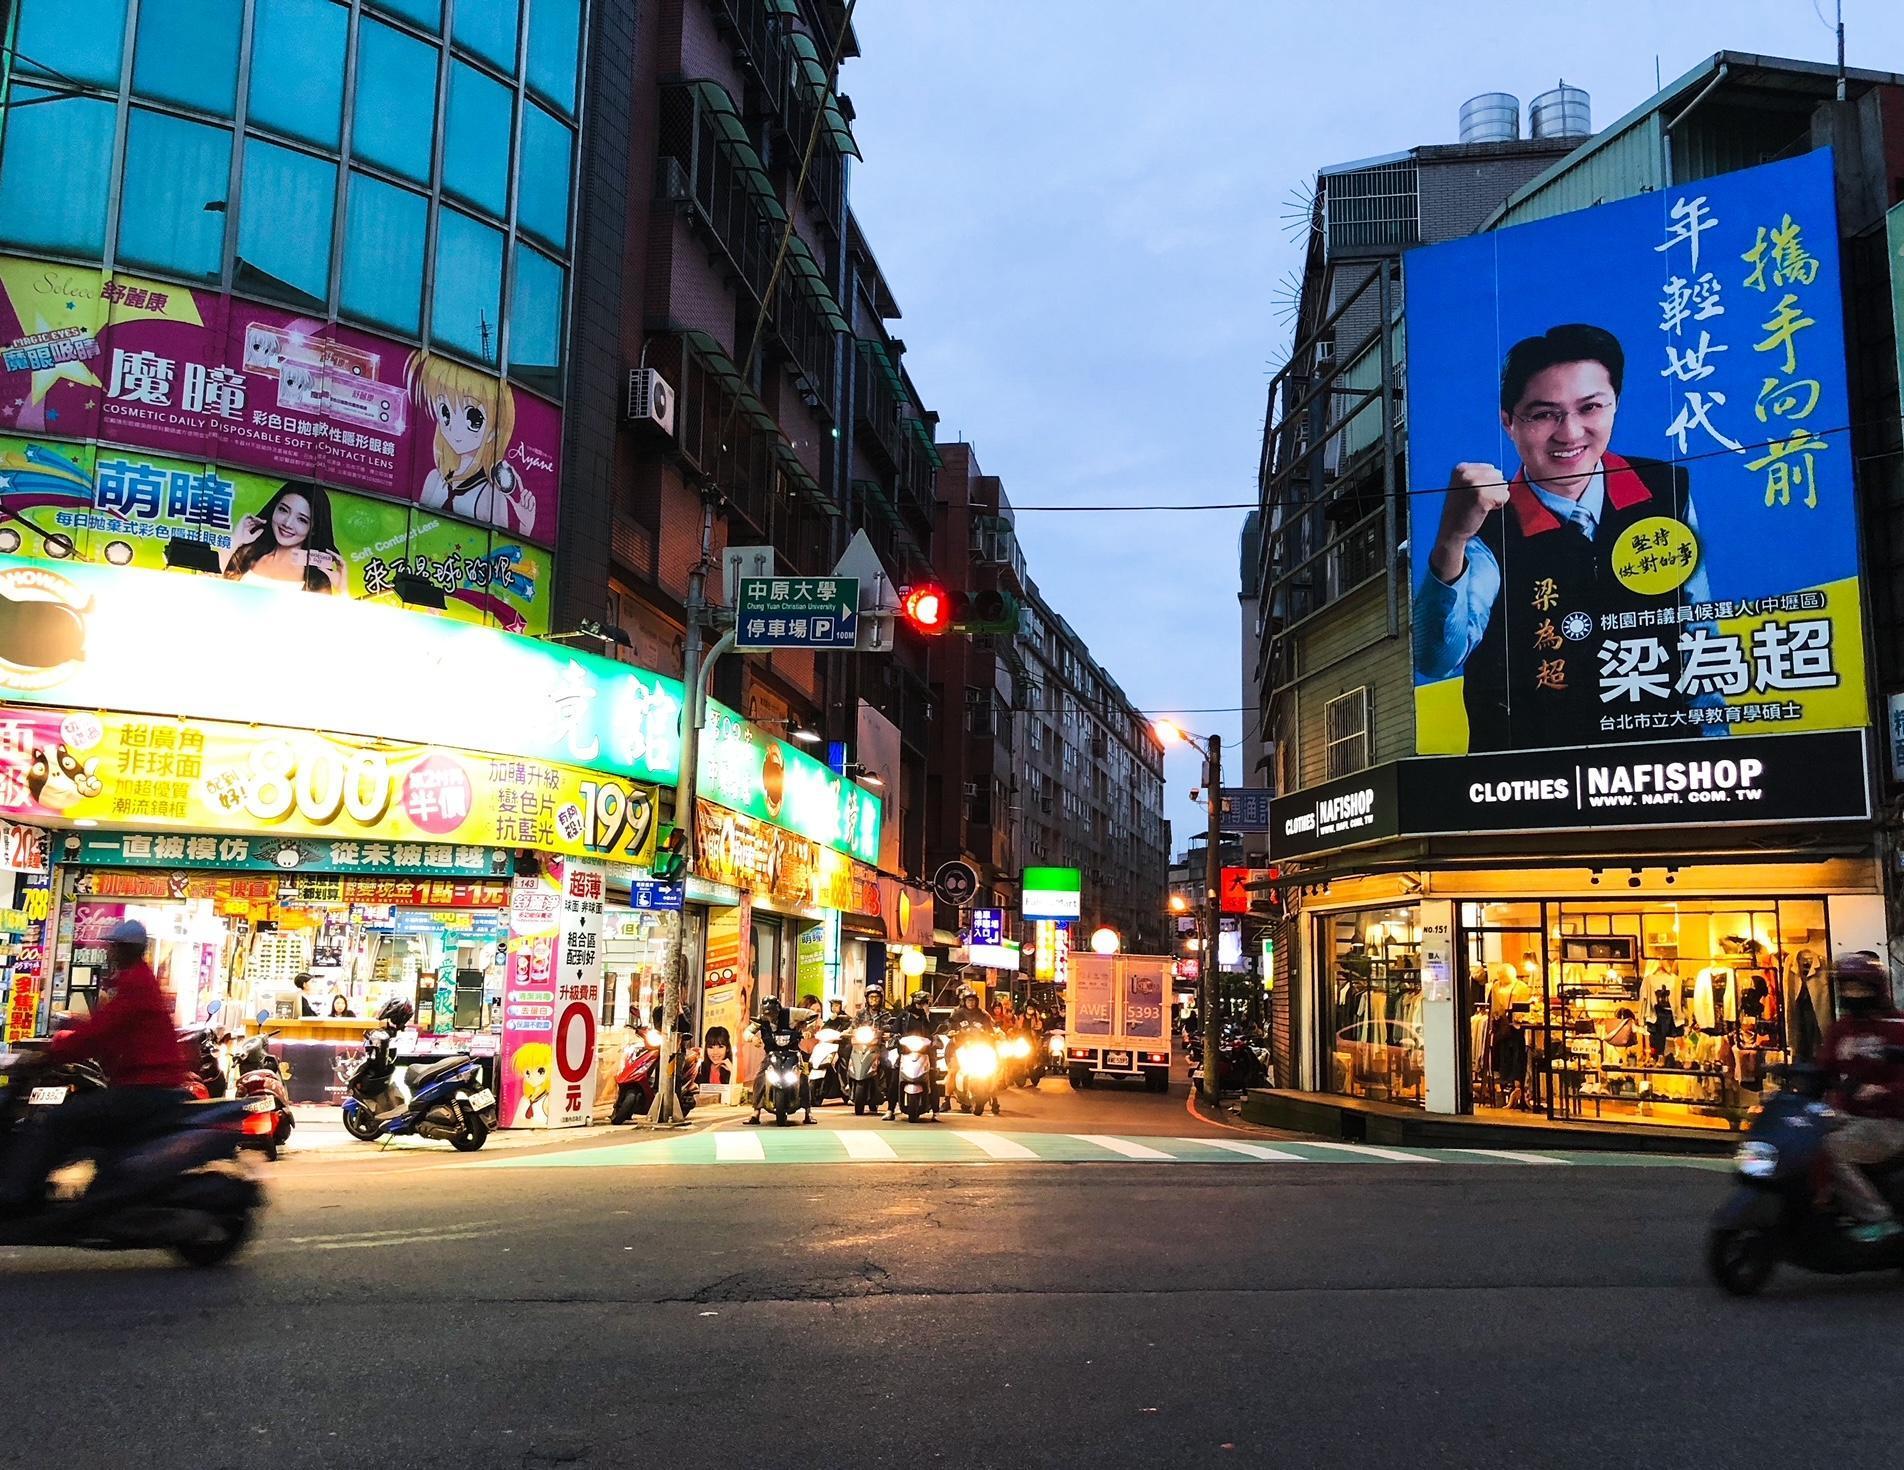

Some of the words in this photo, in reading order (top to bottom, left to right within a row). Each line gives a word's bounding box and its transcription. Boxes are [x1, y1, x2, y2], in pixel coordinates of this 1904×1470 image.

[101, 280, 168, 315] 舒麗康
[13, 332, 50, 348] MAGIC
[51, 327, 80, 341] EYES
[1654, 196, 1746, 454] 年輕世代
[1740, 213, 1828, 508] 攜手向前
[107, 348, 247, 421] 魔瞳
[103, 403, 166, 422] COSMETIC
[169, 414, 206, 428] DAILY
[210, 418, 281, 444] DISPOSABLE
[284, 437, 313, 450] SOFT
[316, 441, 366, 463] CONTACT
[368, 455, 394, 470] LENS
[95, 459, 235, 530] 萌瞳
[350, 546, 372, 563] Soft
[374, 529, 417, 553] Contact
[416, 518, 440, 535] Lens
[1632, 528, 1670, 554] 堅持
[1619, 542, 1693, 579] 做對的事
[748, 581, 837, 601] 中原大學
[746, 602, 765, 612] Chung
[766, 602, 781, 612] Yuan
[781, 602, 807, 611] Christian
[807, 602, 837, 612] University
[1600, 591, 1826, 631] 桃園市議員候選人(中壢區)
[747, 619, 808, 639] 停車場
[815, 620, 831, 638] P
[836, 631, 855, 640] 100M
[1531, 577, 1568, 691] 梁為超
[1596, 620, 1837, 704] 梁為超
[1599, 702, 1802, 731] 台北市立大學教育學碩士
[119, 722, 206, 752] 超廣角
[117, 748, 203, 779] 非球面
[489, 759, 561, 791] 加購升級
[114, 778, 190, 800] 加超優質
[243, 735, 393, 828] 800
[1469, 778, 1570, 803] CLOTHES
[1587, 758, 1763, 795] NAFISHOP
[111, 796, 189, 819] 潮流鏡框
[496, 789, 556, 819] 變色片
[1285, 812, 1316, 836] CLOTHES
[1319, 788, 1375, 824] NAFISHOP
[1588, 795, 1637, 807] WWW.
[1642, 793, 1683, 805] NAFI.
[1688, 791, 1731, 803] COM.
[1735, 788, 1763, 801] TW
[496, 818, 556, 847] 抗藍光
[579, 781, 651, 857] 199
[1364, 814, 1374, 825] TW
[88, 834, 250, 862] 一直被模仿
[330, 842, 485, 869] 從未被超越
[520, 879, 535, 888] 143
[568, 869, 602, 899] 超薄
[565, 899, 580, 913] 球面
[581, 901, 603, 915] 非球面
[567, 931, 597, 949] 組合區
[974, 928, 991, 938] 入口
[1423, 925, 1448, 935] NO.151
[565, 948, 597, 966] 配到好
[559, 983, 599, 1001] 升級費用
[1079, 1004, 1108, 1017] AWE
[1127, 1006, 1160, 1019] 5393
[555, 1002, 596, 1084] 0
[565, 1084, 582, 1113] 元
